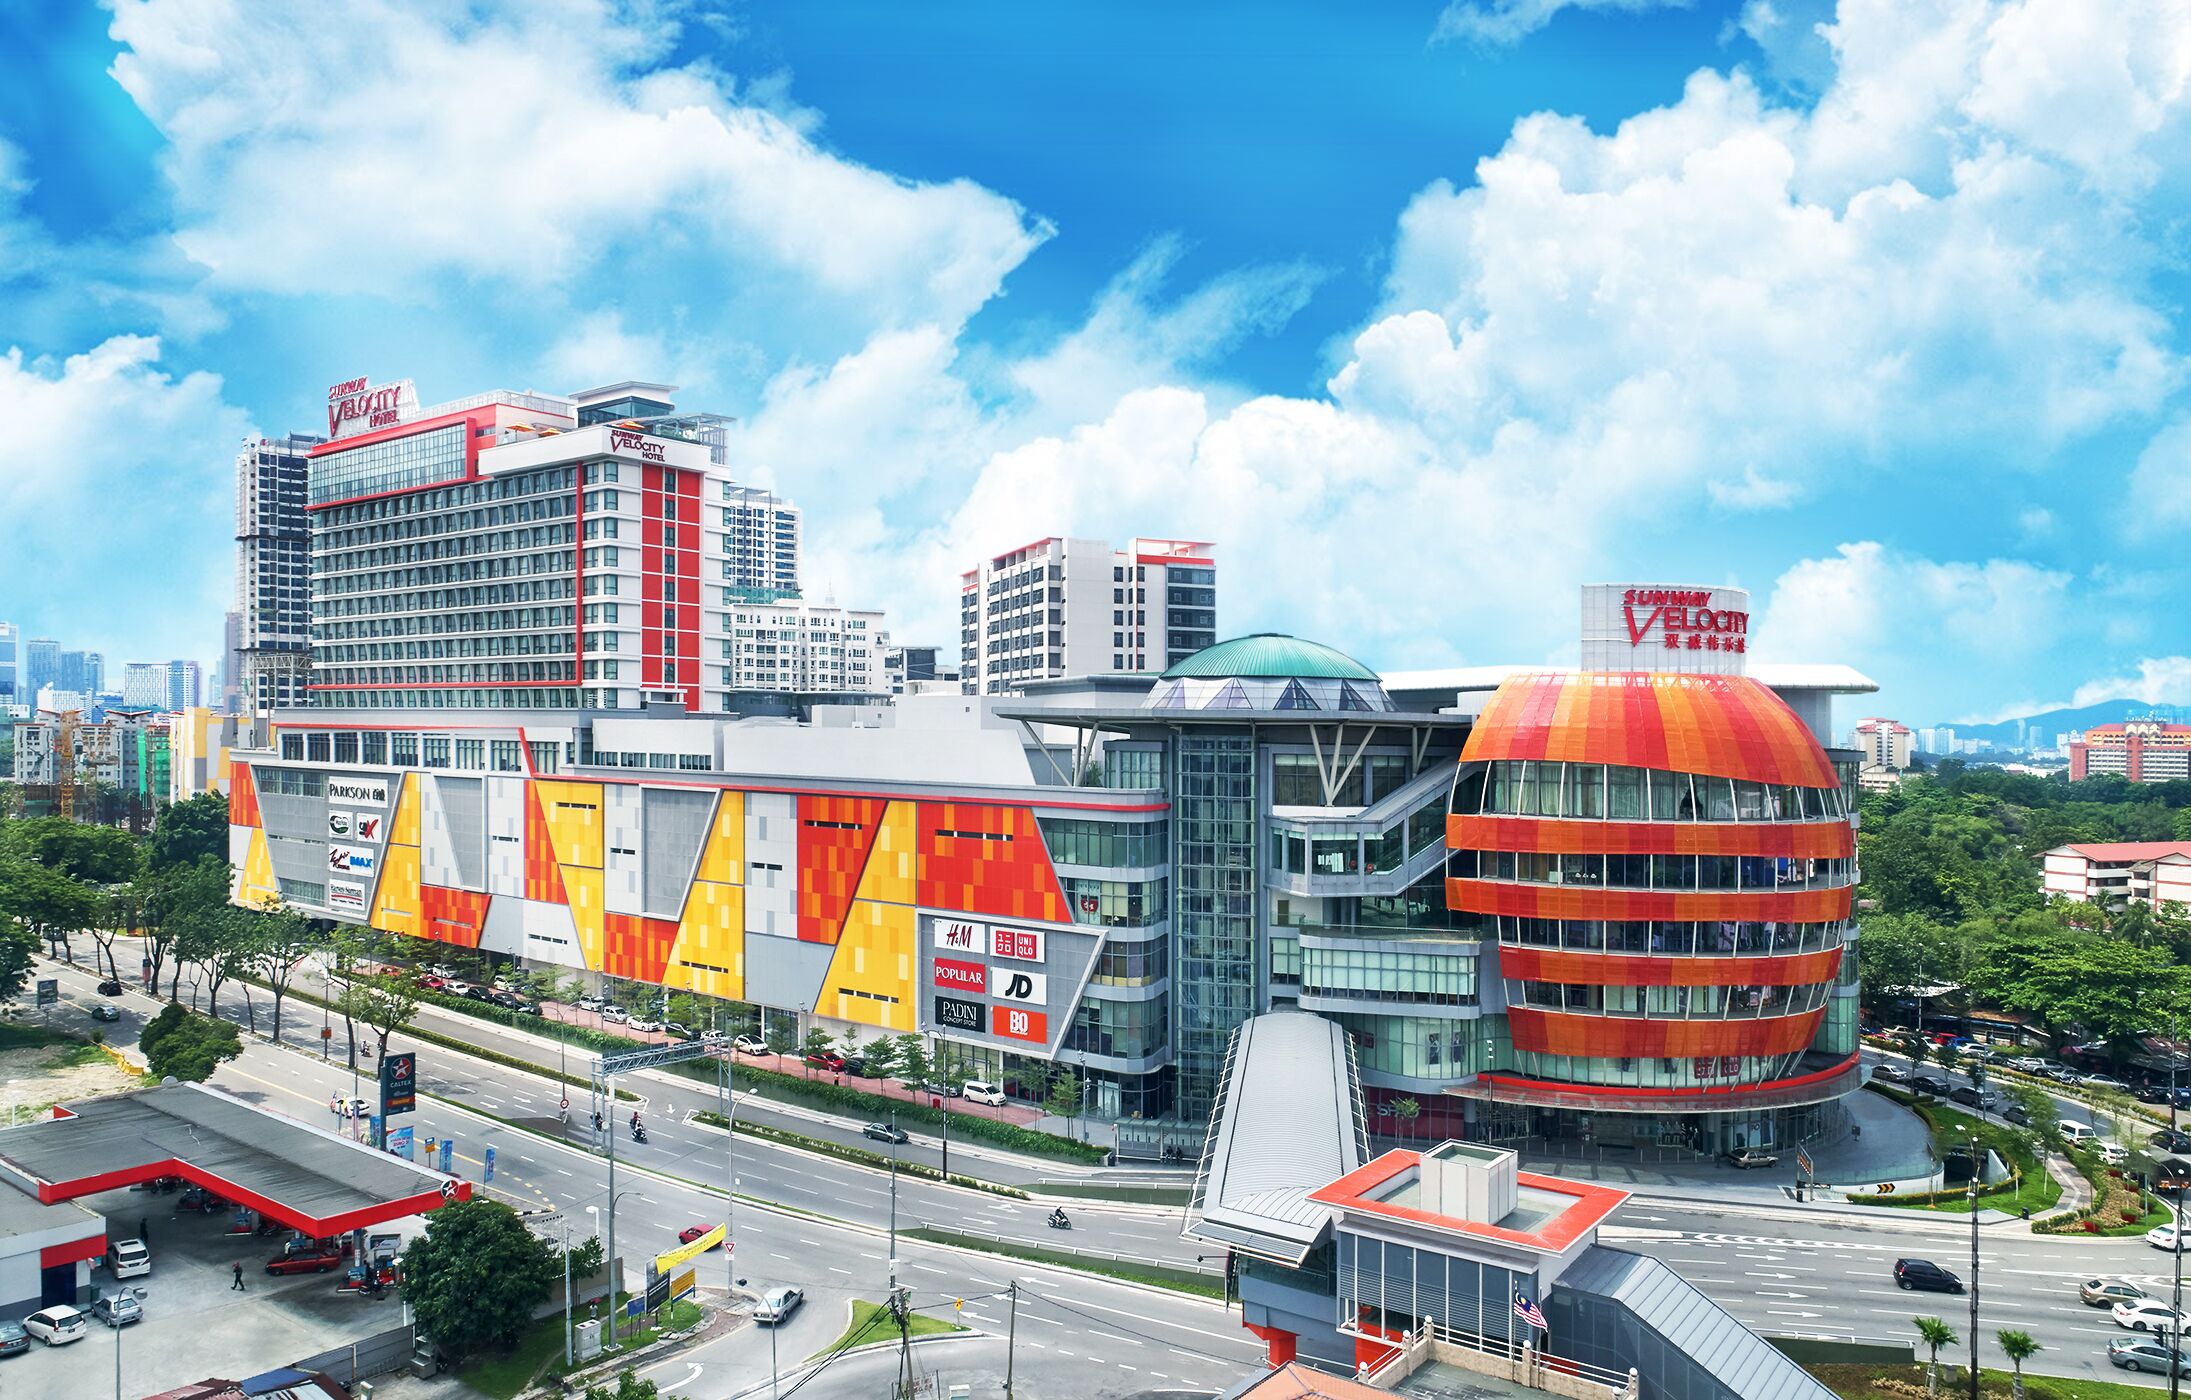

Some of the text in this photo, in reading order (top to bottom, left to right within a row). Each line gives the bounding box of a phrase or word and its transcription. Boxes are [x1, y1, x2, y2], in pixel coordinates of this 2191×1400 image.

[328, 376, 367, 399] SUNWAY
[328, 386, 401, 437] VELOCITY
[369, 410, 400, 428] HOTEL
[611, 429, 644, 441] SUNWAY
[610, 436, 665, 454] VELOCITY
[642, 451, 665, 462] HOTEL
[1623, 589, 1712, 606] SUNWAY
[1623, 606, 1749, 648] VELOCITY
[329, 783, 371, 800] PARKSON
[946, 923, 973, 949] H&M
[1018, 936, 1032, 947] UNI
[1018, 946, 1033, 956] QLO
[935, 966, 984, 985] POPULAR
[1005, 974, 1033, 998] JD
[943, 1001, 977, 1021] PADINI
[943, 1015, 977, 1027] CONCEPT STORE
[390, 1080, 412, 1088] CALTEX
